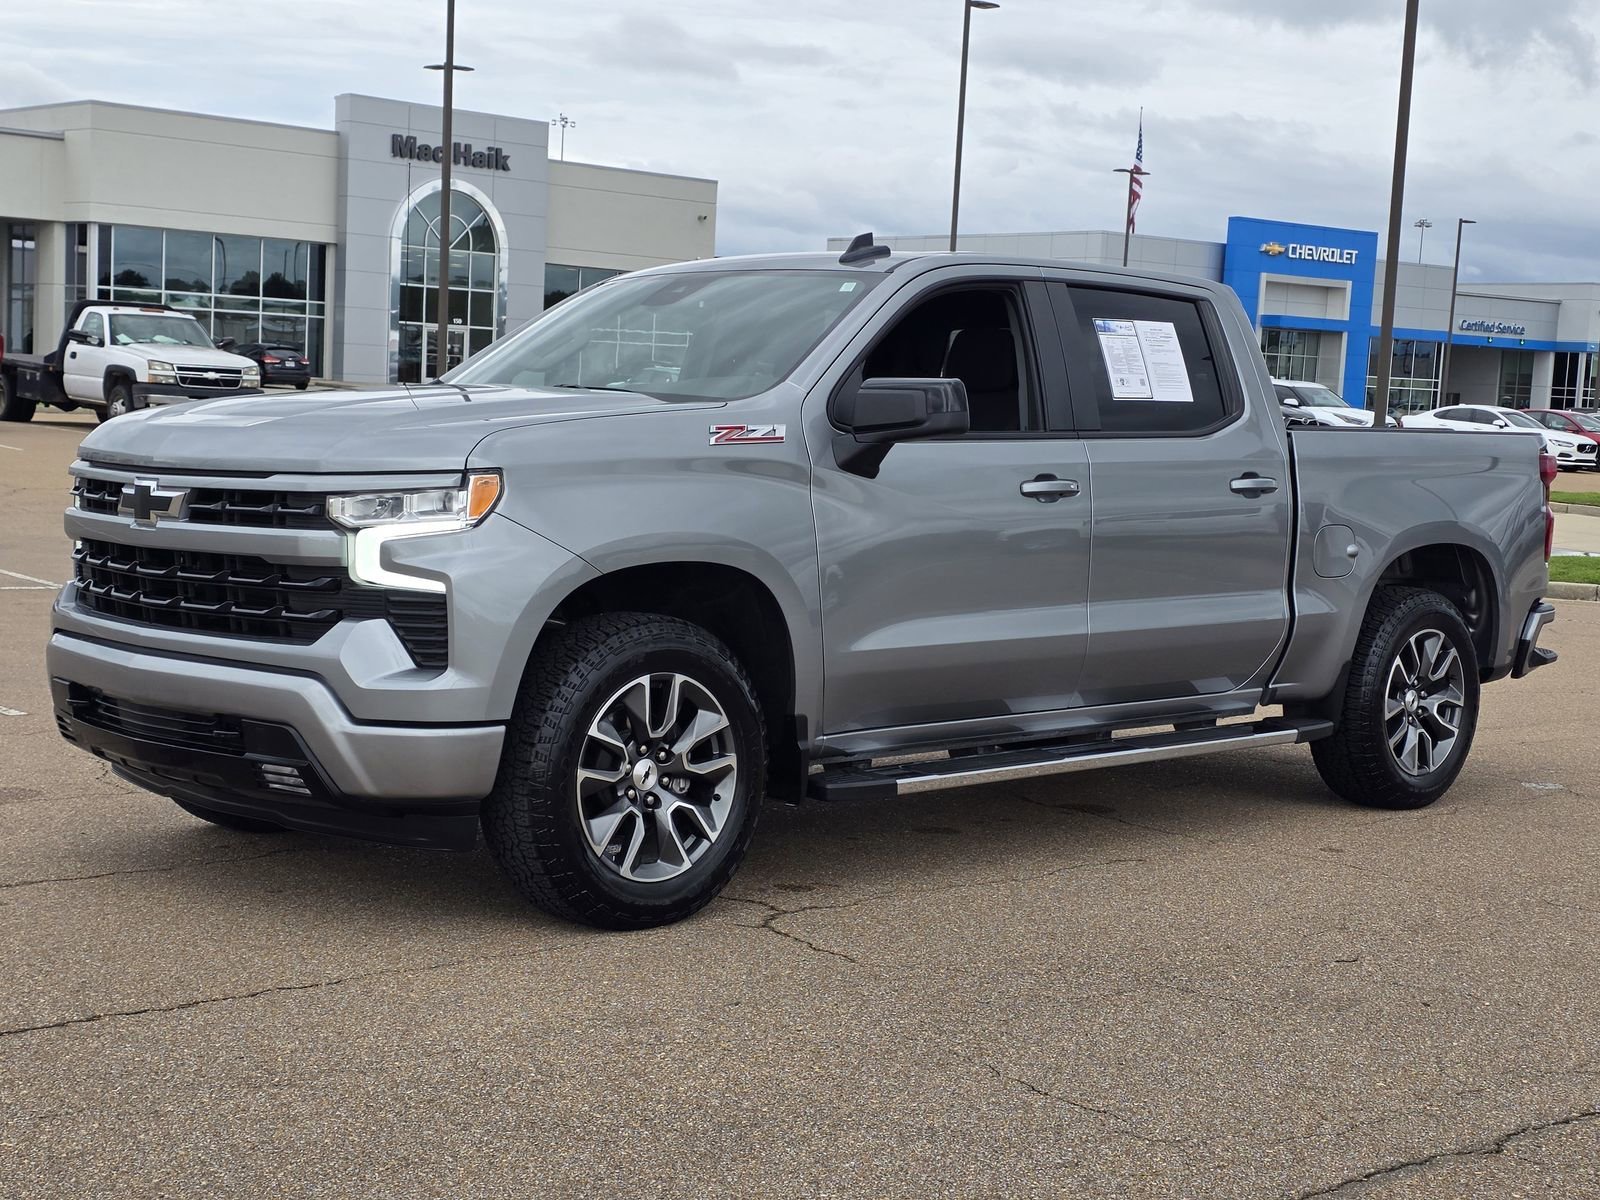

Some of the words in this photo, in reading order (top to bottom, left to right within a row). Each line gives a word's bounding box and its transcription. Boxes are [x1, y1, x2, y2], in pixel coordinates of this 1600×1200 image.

[391, 134, 444, 163] Mac
[453, 142, 511, 171] Haik
[1288, 243, 1358, 264] CHEVROLET
[1460, 320, 1495, 332] Certified
[1495, 323, 1525, 335] Service
[709, 424, 786, 445] Z71
